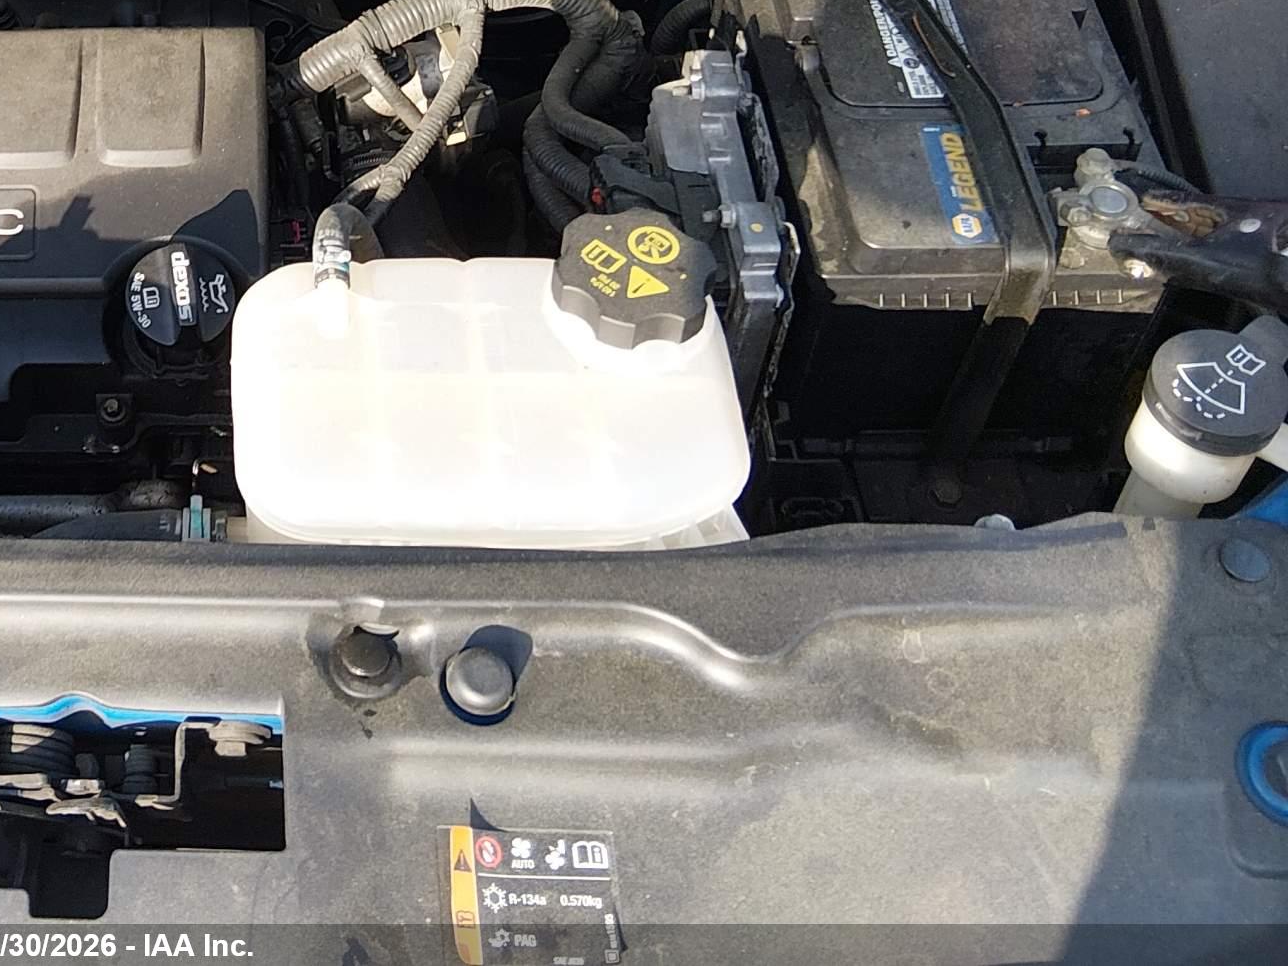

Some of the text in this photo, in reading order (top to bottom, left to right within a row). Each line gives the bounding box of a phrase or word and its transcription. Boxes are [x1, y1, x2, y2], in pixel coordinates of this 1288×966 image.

[940, 132, 983, 213] LEGEND
[130, 272, 152, 328] SAE 5W-30
[171, 251, 192, 322] dexos
[511, 859, 535, 869] AUTO
[508, 893, 603, 909] R-134a 0.570kg
[514, 934, 537, 947] PAG
